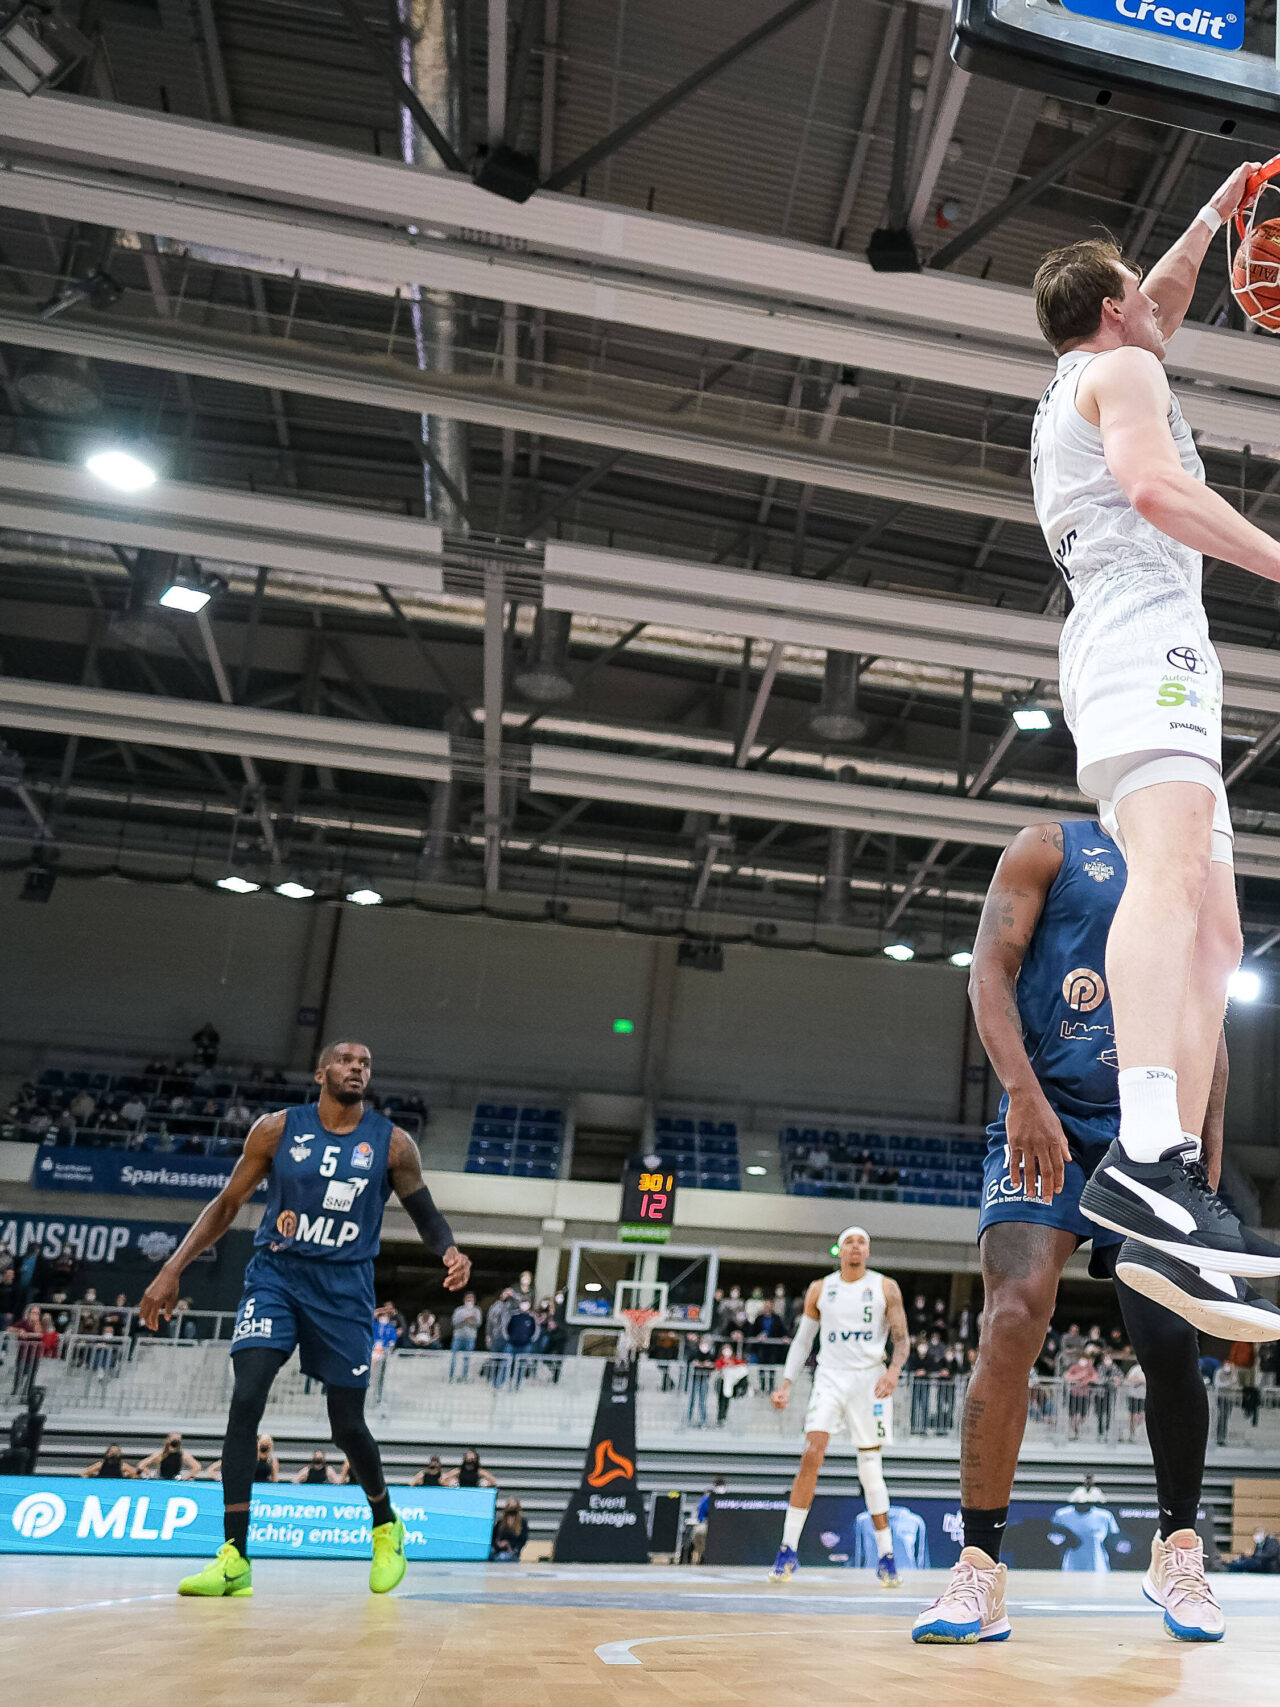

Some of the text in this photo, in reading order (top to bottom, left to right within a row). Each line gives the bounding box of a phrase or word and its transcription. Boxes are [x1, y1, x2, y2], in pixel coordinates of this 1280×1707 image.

[1169, 722, 1207, 736] SPALDING
[319, 1145, 341, 1177] 5
[326, 1197, 351, 1209] SNP
[640, 1194, 667, 1219] 12
[295, 1213, 360, 1248] MLP
[0, 1219, 130, 1263] ANSHOP
[862, 1306, 873, 1324] 5
[841, 1331, 873, 1342] VTG
[877, 1421, 886, 1438] 5
[77, 1495, 198, 1540] MLP
[249, 1500, 328, 1519] inanzen
